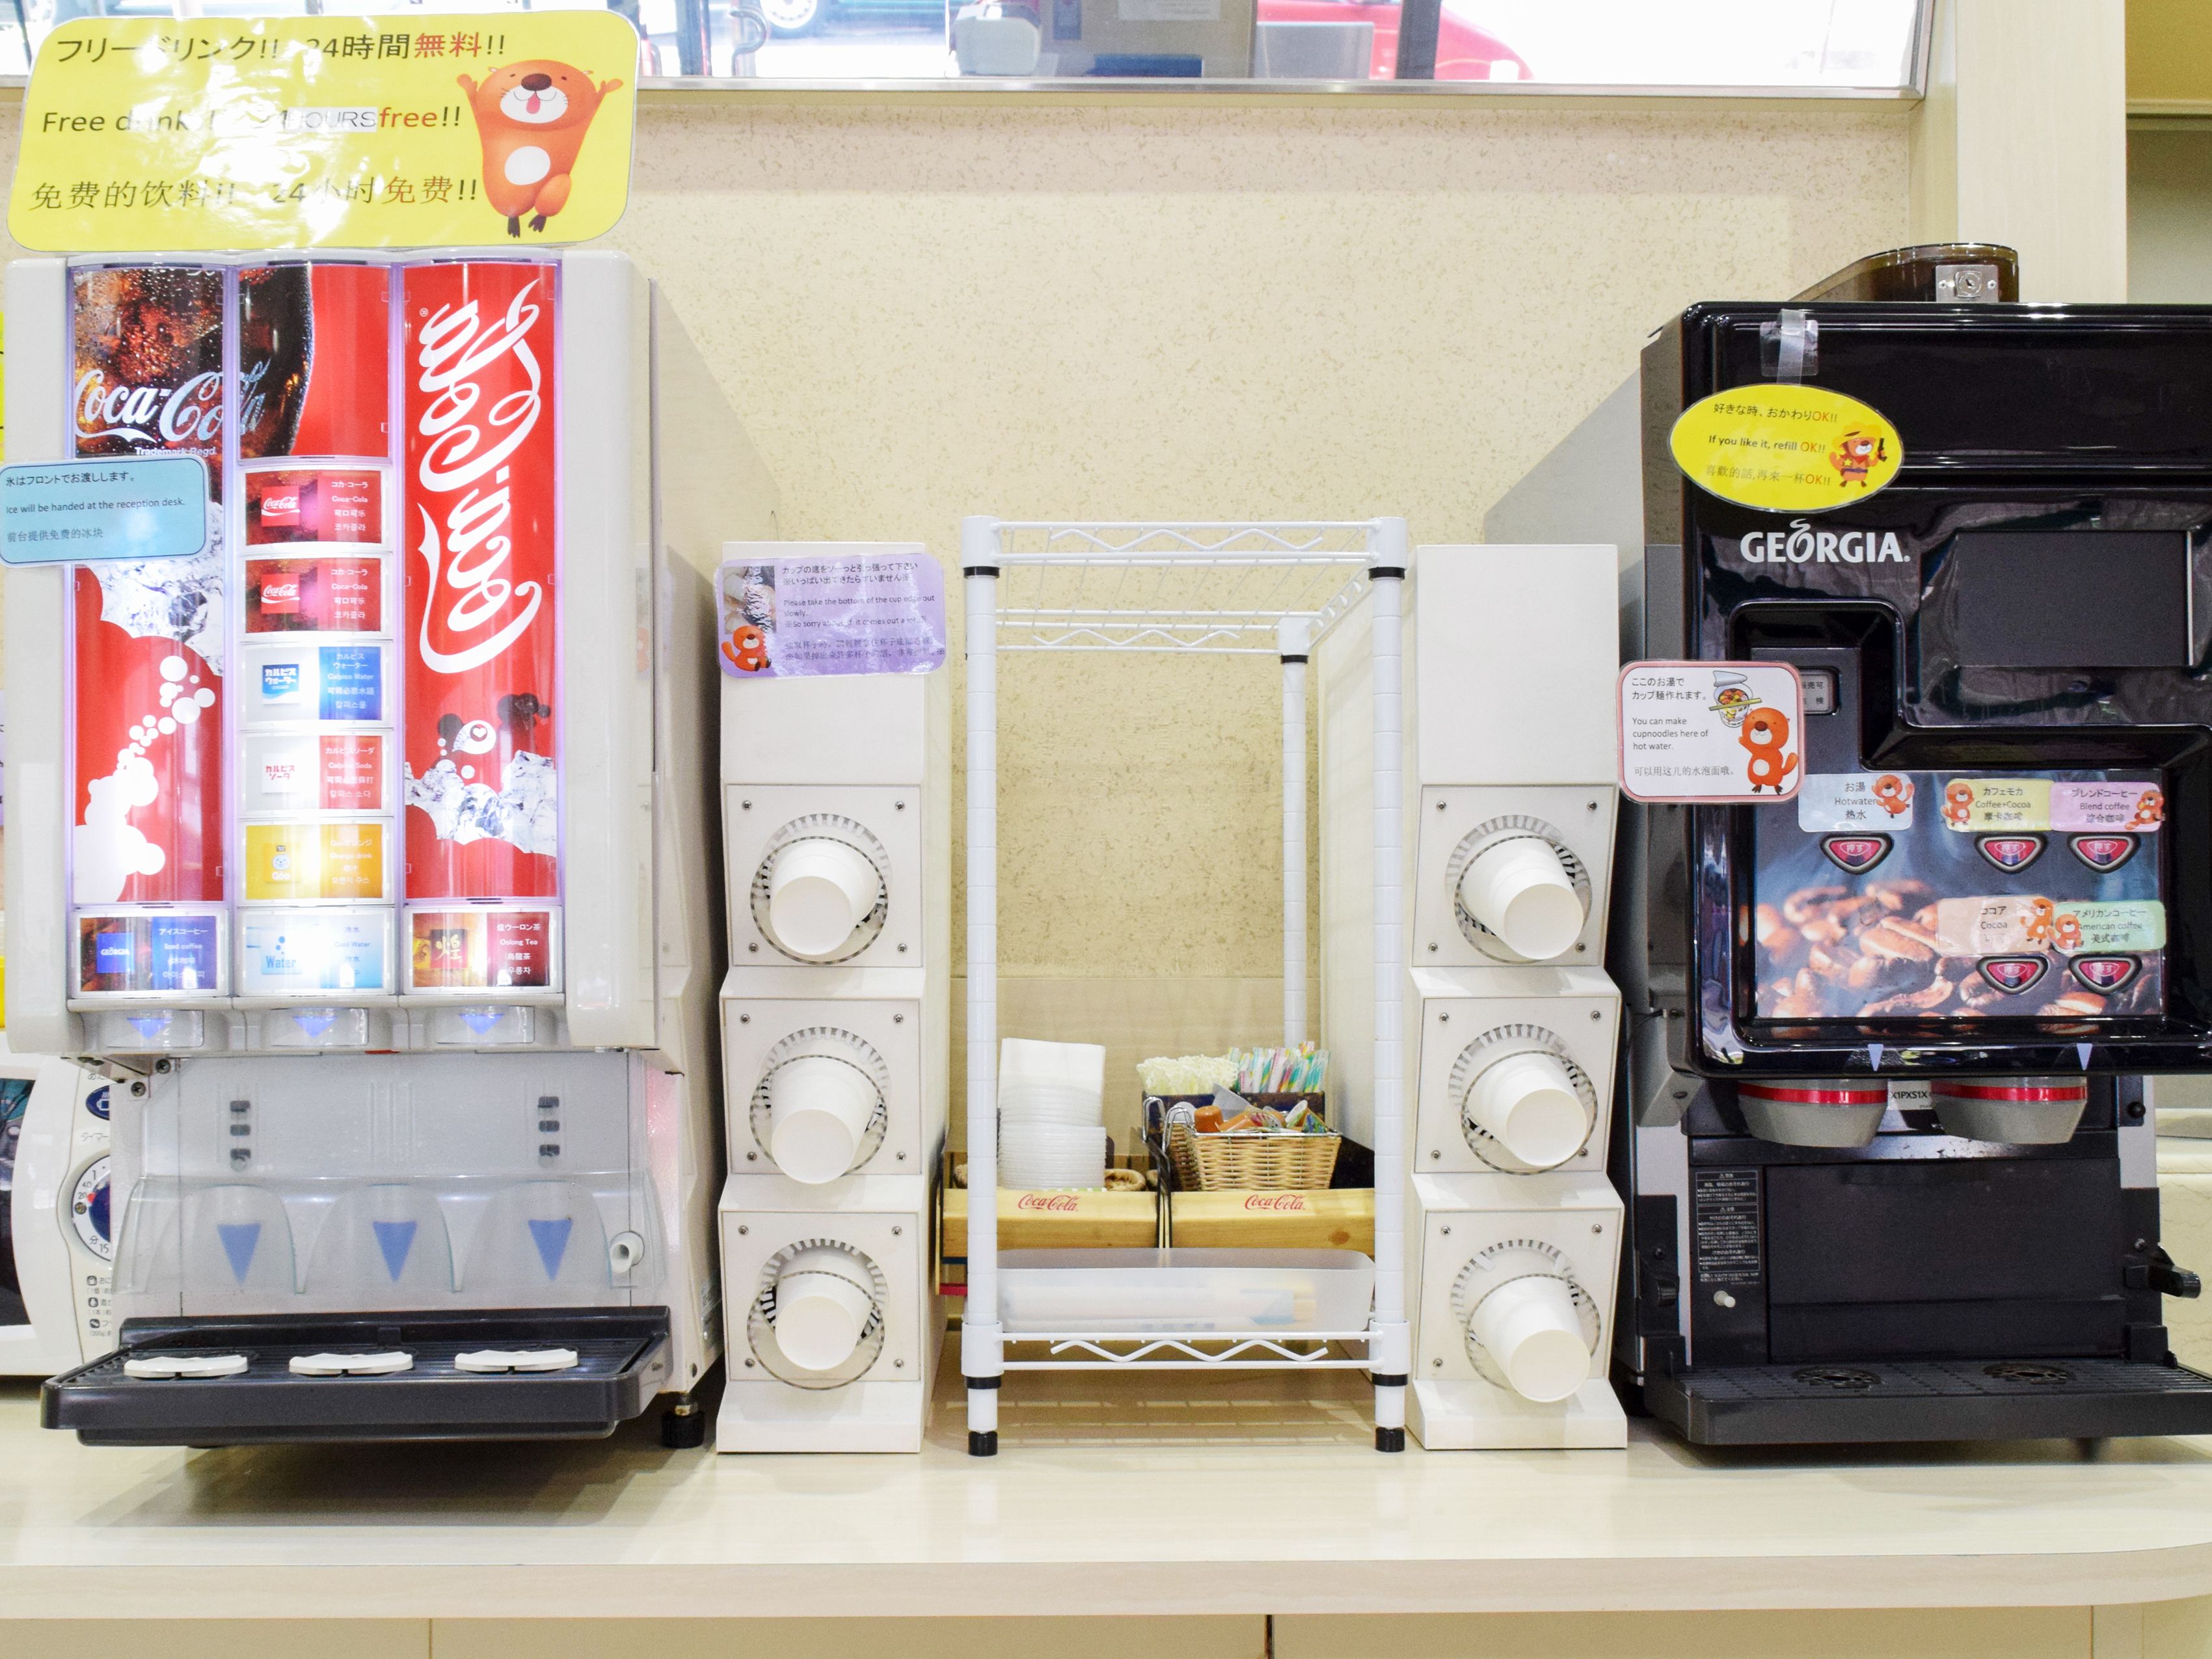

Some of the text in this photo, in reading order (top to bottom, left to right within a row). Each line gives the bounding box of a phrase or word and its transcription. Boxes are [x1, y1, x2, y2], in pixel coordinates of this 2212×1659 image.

[43, 111, 105, 133] Free
[29, 180, 236, 210] 免费的饮料!!
[1714, 403, 1838, 423] 好きな時、おかわりOK!!
[1708, 435, 1826, 453] If you like it, refill OK!!
[5, 470, 135, 487] 氷はフロントでお渡しします。
[416, 277, 542, 674] Coca-Cola
[20, 504, 36, 513] will
[37, 503, 49, 512] be
[51, 501, 85, 511] handed
[87, 501, 96, 509] at
[98, 500, 114, 509] the
[116, 498, 160, 510] reception
[162, 497, 186, 507] desk.
[7, 527, 104, 543] 前台提供免费的冰块
[1740, 519, 1904, 563] GEORGIA
[783, 599, 807, 607] Please
[889, 596, 902, 604] cup
[784, 610, 809, 618] slowly.
[803, 620, 821, 629] sorry
[1632, 677, 1684, 688] ここのお湯で
[1632, 691, 1707, 701] カップ麺作れます。
[1666, 717, 1687, 725] make
[1632, 729, 1679, 739] cupnoodles
[1680, 729, 1698, 738] here
[1633, 742, 1675, 751] hot water.
[1634, 766, 1734, 777] 可以用这儿的水泡面哦。
[1844, 782, 1866, 792] お湯
[1982, 787, 2024, 796] カフェモカ
[2071, 789, 2138, 798] ブレンドコーヒー
[1834, 797, 1876, 806] Hotwater
[1975, 800, 2032, 809] Coffee+Cocoa
[1845, 809, 1867, 820] 热水
[1981, 906, 2007, 916] ココア
[2073, 908, 2147, 918] アメリカンコーヒー
[1980, 921, 2008, 930] Cocoa
[2079, 922, 2143, 930] American coffee
[158, 928, 209, 936] アイスコーヒー
[500, 938, 524, 947] Oolong
[265, 954, 297, 969] Water
[92, 1170, 96, 1181] 1
[1018, 1193, 1078, 1212] Coca-Cola
[1244, 1193, 1306, 1212] Coca-Cola
[100, 1243, 109, 1254] 15
